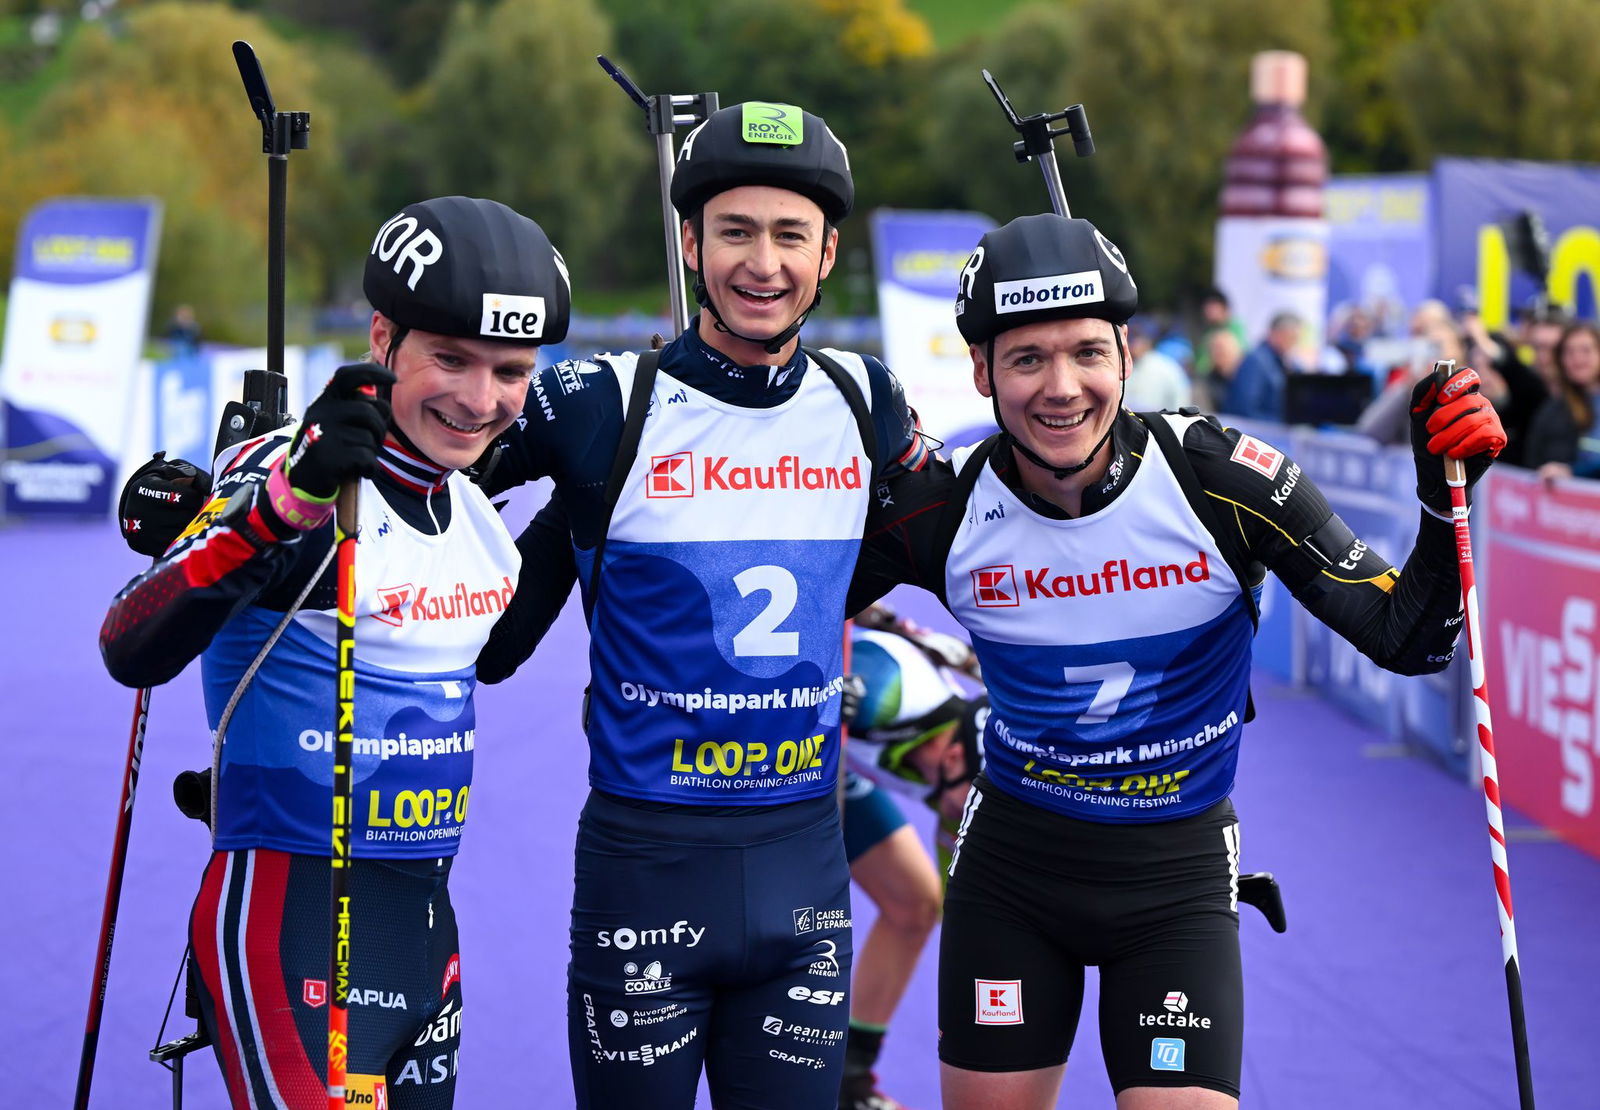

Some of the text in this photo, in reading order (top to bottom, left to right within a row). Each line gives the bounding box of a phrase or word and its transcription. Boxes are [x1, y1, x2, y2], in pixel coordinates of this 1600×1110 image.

[748, 122, 780, 133] ROY
[748, 132, 794, 141] ENERGIE
[1000, 282, 1095, 307] robotron
[489, 298, 539, 335] ice
[703, 455, 862, 491] Kaufland
[1024, 550, 1211, 600] Kaufland
[410, 576, 515, 621] Kaufland
[732, 564, 800, 657] 2
[339, 639, 356, 743] LEKI
[620, 681, 788, 714] Olympiapark
[1063, 661, 1137, 725] 7
[298, 728, 463, 761] Olmpiapark
[1138, 709, 1239, 761] München
[671, 733, 826, 777] LOOP ONE
[670, 770, 823, 790] BIATHLON OPENING FESTIVAL
[1021, 775, 1182, 808] BIATHLON OPENING FESTIVAL
[367, 788, 453, 829] LOOP
[365, 829, 427, 843] BIATHLON
[427, 828, 460, 841] OPENING
[815, 909, 845, 921] CAISSE
[596, 920, 706, 951] somfy
[624, 975, 672, 992] COMTÉ
[583, 992, 603, 1049] CRAFT
[632, 1002, 679, 1018] Auvergne-
[633, 1006, 688, 1027] Rhône-Alpes
[981, 1009, 1017, 1018] Kaufland
[1138, 1012, 1212, 1029] tectake
[603, 1026, 698, 1067] VIESSMANN
[784, 1023, 844, 1041] Jean Lain
[793, 1035, 836, 1047] MOBILITÉS
[768, 1048, 816, 1069] CRAFT
[1156, 1042, 1179, 1067] TQ
